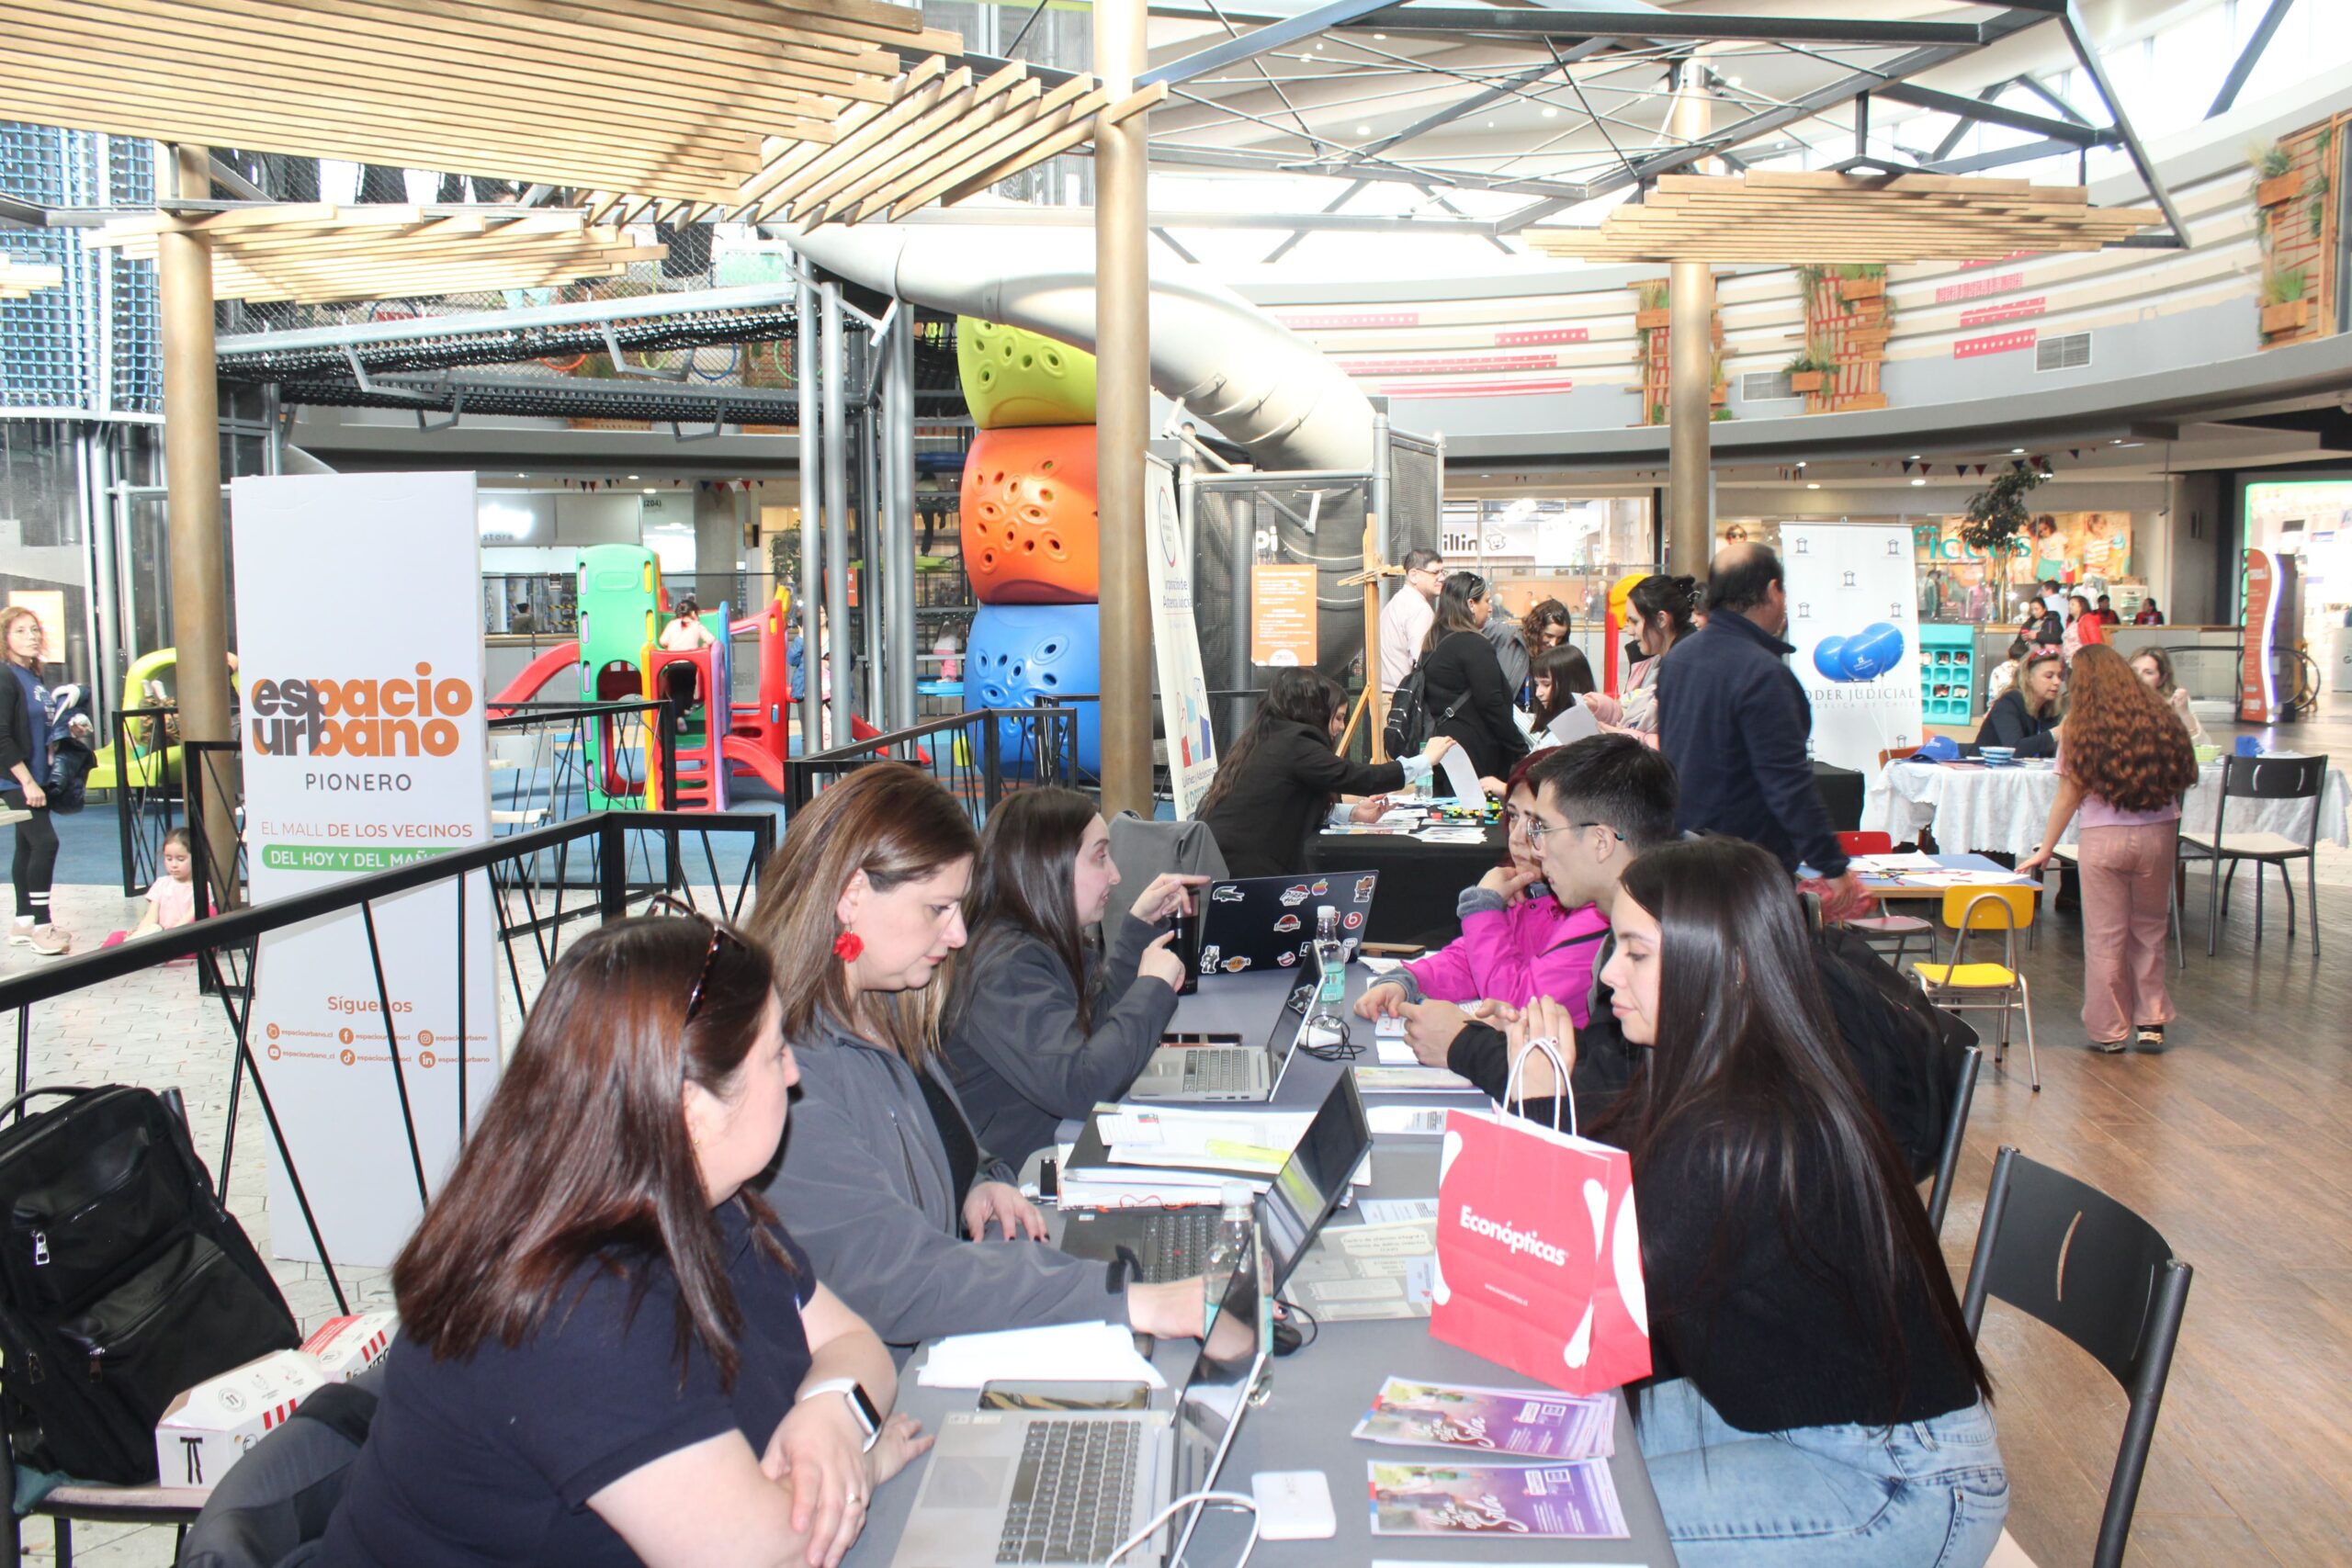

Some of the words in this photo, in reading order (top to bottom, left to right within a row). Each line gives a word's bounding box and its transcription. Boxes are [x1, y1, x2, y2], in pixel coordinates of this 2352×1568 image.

[252, 661, 473, 717] espacio
[1804, 689, 1843, 701] ODER
[1849, 688, 1915, 702] JUDICIAL
[252, 717, 459, 757] urbano
[306, 773, 413, 791] PIONERO
[261, 821, 278, 836] EL
[282, 822, 323, 837] MALL
[327, 824, 351, 837] DE
[355, 824, 388, 838] LOS
[392, 824, 473, 838] VECINOS
[270, 850, 298, 865] DEL
[302, 852, 334, 866] HOY
[338, 852, 349, 866] Y
[354, 853, 385, 867] DEL
[390, 850, 435, 867] MAÑ
[1460, 1204, 1566, 1267] Econópticas
